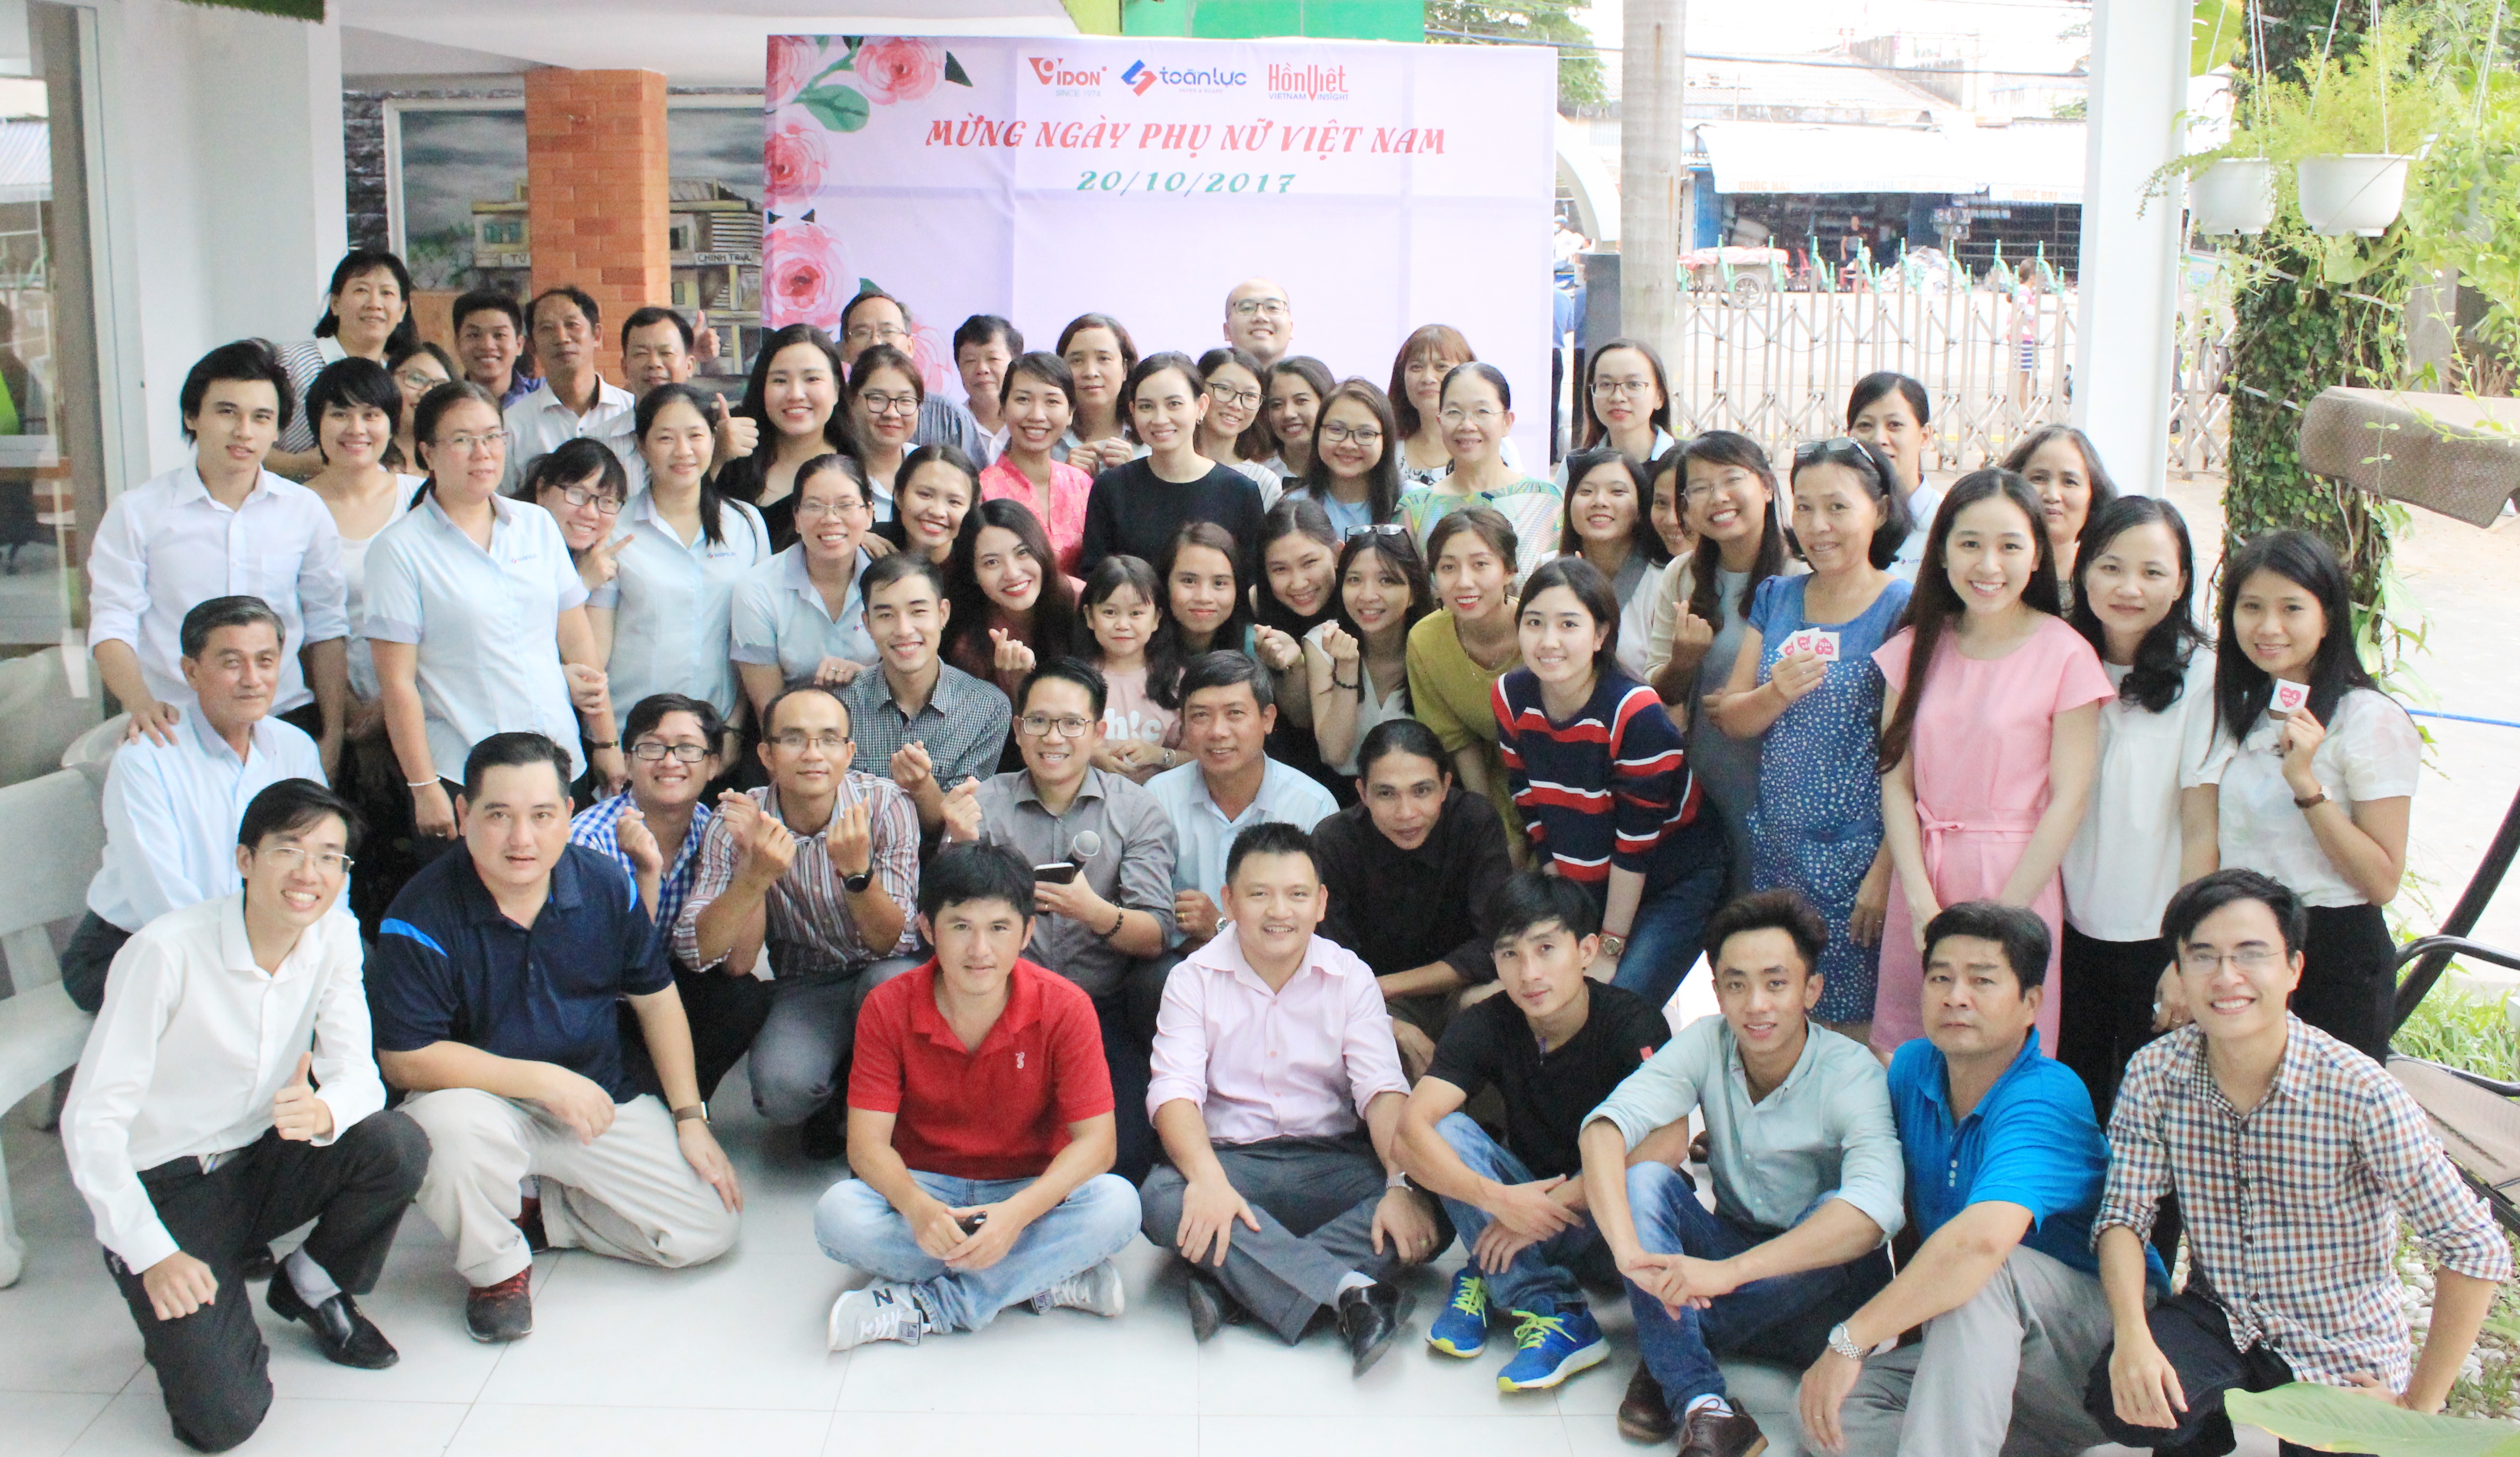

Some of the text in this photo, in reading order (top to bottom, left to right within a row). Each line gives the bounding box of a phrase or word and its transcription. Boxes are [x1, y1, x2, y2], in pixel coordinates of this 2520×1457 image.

[925, 112, 1445, 161] MỪNG NGÀY PHỤ NỮ VIỆT NAM
[1077, 170, 1297, 197] 20/10/2017
